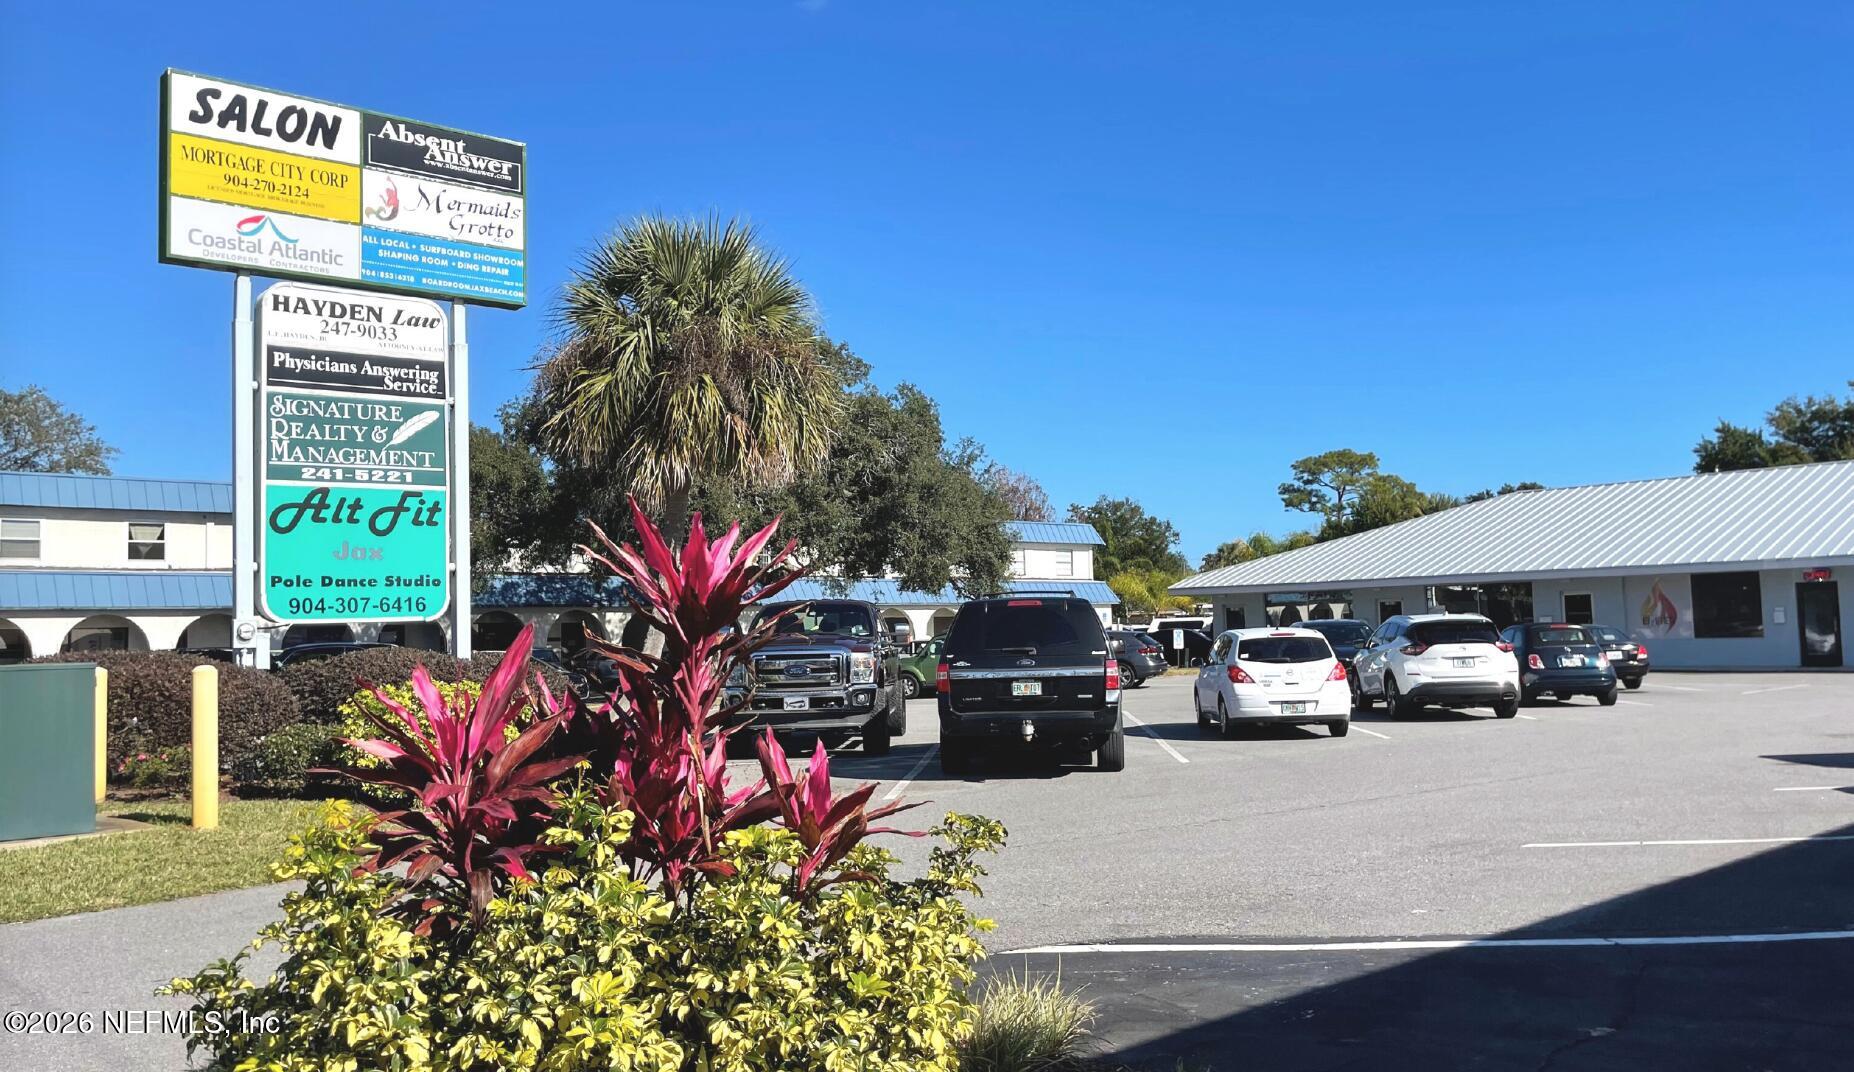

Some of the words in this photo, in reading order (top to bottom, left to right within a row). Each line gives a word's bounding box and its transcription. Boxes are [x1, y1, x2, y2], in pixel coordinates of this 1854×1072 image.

[188, 87, 342, 150] SALON
[378, 120, 466, 154] Absent
[181, 144, 266, 175] MORTGAGE
[270, 161, 306, 181] CITY
[310, 169, 349, 189] CORP
[423, 160, 512, 181] www.absentanswer.com
[424, 143, 512, 175] Answer
[223, 173, 309, 199] 904-270-2124
[403, 184, 521, 220] Mermaids
[449, 214, 514, 239] Grotto
[188, 228, 263, 255] Coastal
[269, 240, 343, 266] Atlantic
[362, 235, 378, 244] ALL
[381, 238, 410, 249] LOCAL
[420, 244, 471, 259] SURFBOARD
[473, 252, 523, 267] SHOWROOM
[203, 249, 259, 264] DEVELOPERS
[269, 258, 330, 274] CONTRACTORS
[378, 249, 419, 262] SHAPING
[421, 255, 448, 267] ROOM
[457, 261, 480, 272] DING
[481, 264, 509, 276] REPAIR
[272, 293, 383, 323] HAYDEN
[391, 309, 441, 329] Law
[320, 319, 398, 342] 247-9033
[273, 351, 357, 374] Physicians
[360, 360, 439, 384] Answering
[383, 376, 438, 394] Service
[270, 395, 404, 422] SIGNATURE
[270, 417, 368, 442] REALTY
[371, 425, 389, 443] &
[270, 439, 435, 467] MANAGEMENT
[301, 467, 413, 483] 241-5221
[269, 486, 364, 534] Alt
[368, 490, 442, 537] Fit
[332, 540, 384, 561] Jax
[270, 575, 313, 588] Pole
[321, 575, 378, 588] Dance
[384, 574, 442, 588] Studio
[288, 596, 427, 615] 904-307-6416
